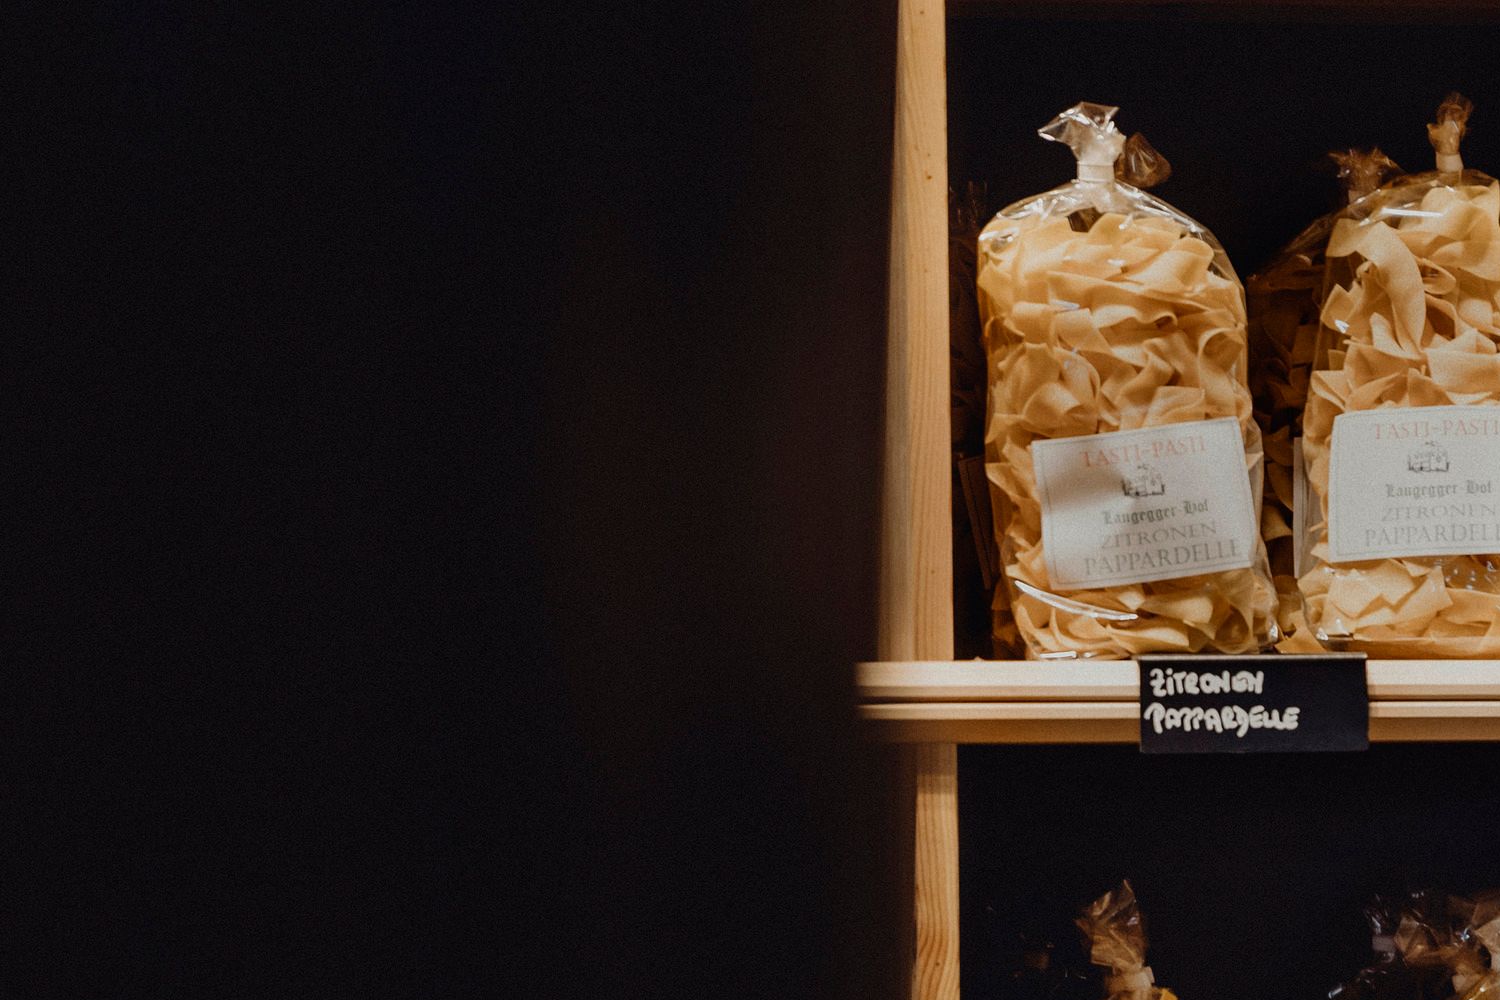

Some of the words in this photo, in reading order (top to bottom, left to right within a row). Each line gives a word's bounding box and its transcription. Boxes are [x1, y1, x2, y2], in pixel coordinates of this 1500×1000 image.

[1081, 435, 1206, 467] TASTI-PASTI
[1380, 503, 1497, 522] ZITRONEN
[1101, 521, 1217, 549] ZITRONEN
[1084, 539, 1240, 576] PAPPARDELLE
